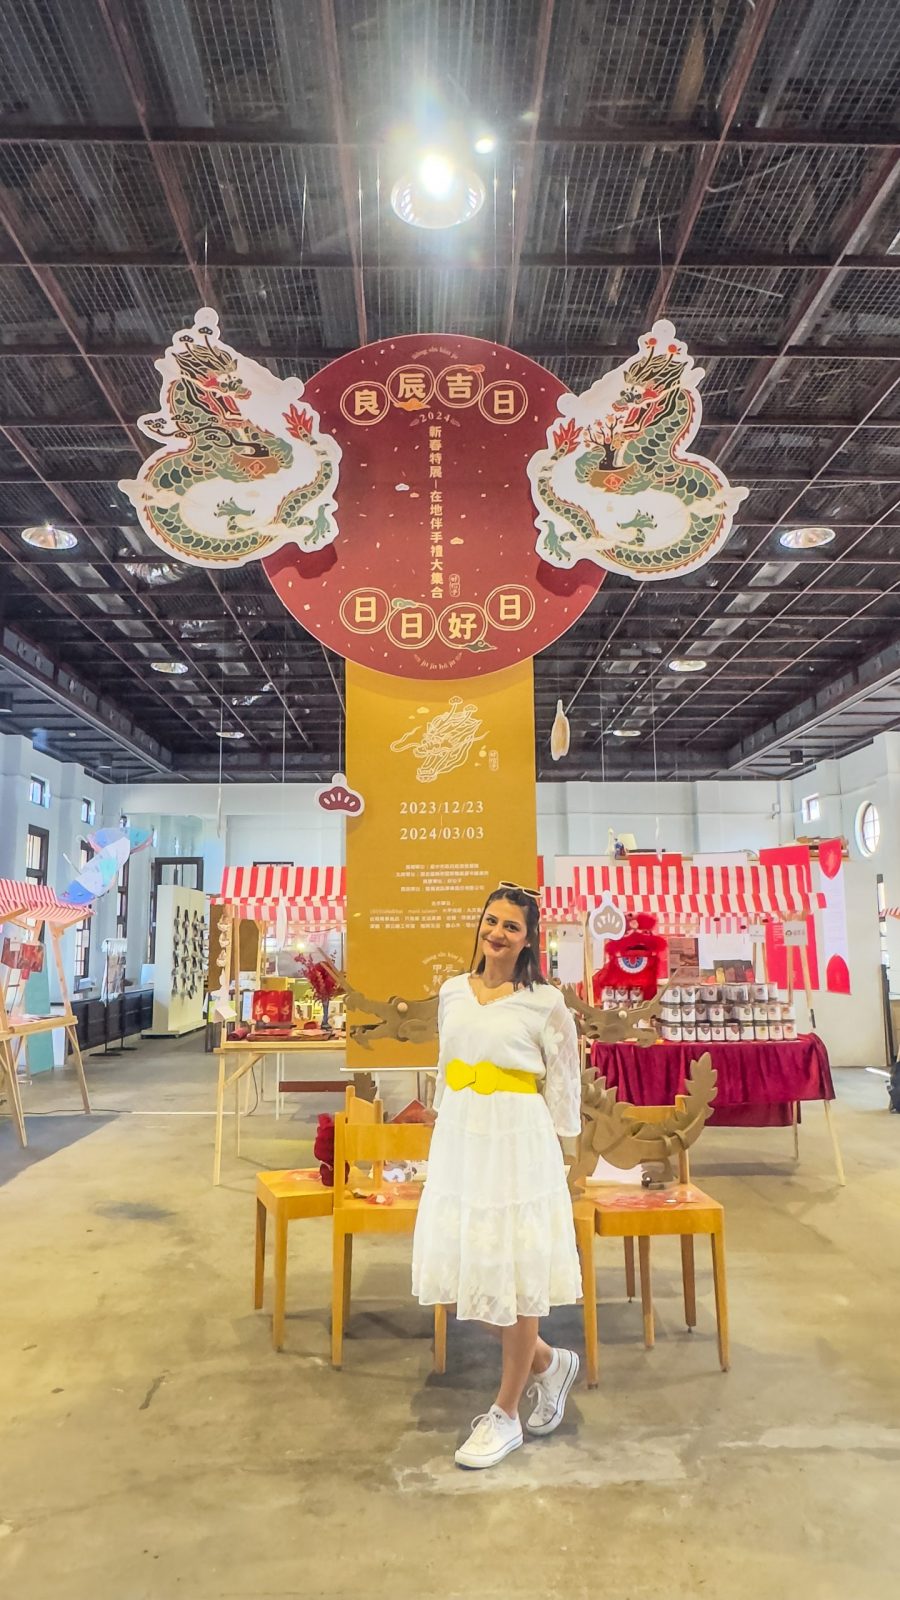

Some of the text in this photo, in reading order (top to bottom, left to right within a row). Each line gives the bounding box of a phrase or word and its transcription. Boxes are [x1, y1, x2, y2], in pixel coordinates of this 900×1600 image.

[353, 372, 514, 416] 良辰吉日
[419, 411, 451, 423] 2024
[354, 594, 522, 641] 日日好日
[399, 801, 484, 814] 2023/12/23
[399, 826, 484, 840] 2024/03/03
